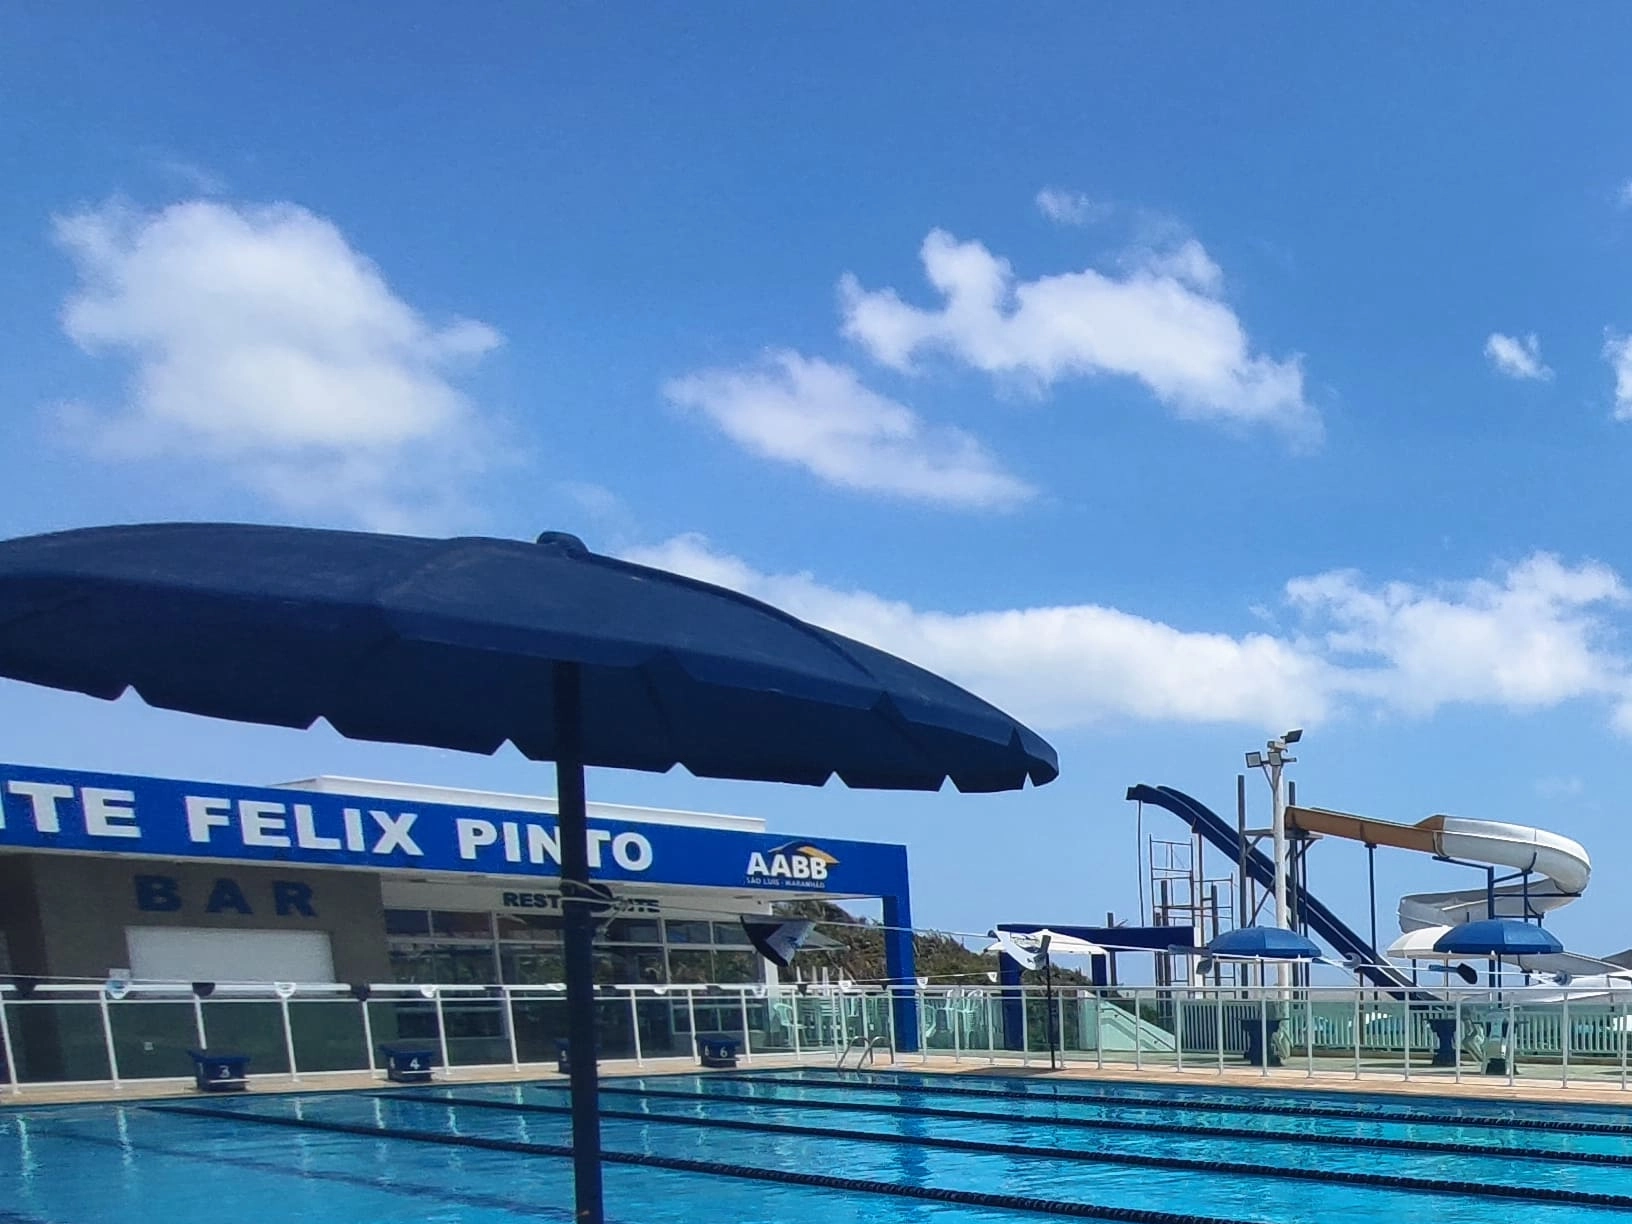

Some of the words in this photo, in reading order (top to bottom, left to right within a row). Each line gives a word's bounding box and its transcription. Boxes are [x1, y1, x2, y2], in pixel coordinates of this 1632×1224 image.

[0, 780, 142, 838] TE
[184, 795, 424, 856] FELIX
[746, 852, 828, 880] AABB
[134, 874, 316, 917] BAR
[409, 1057, 421, 1070] 4
[720, 1046, 728, 1058] 6
